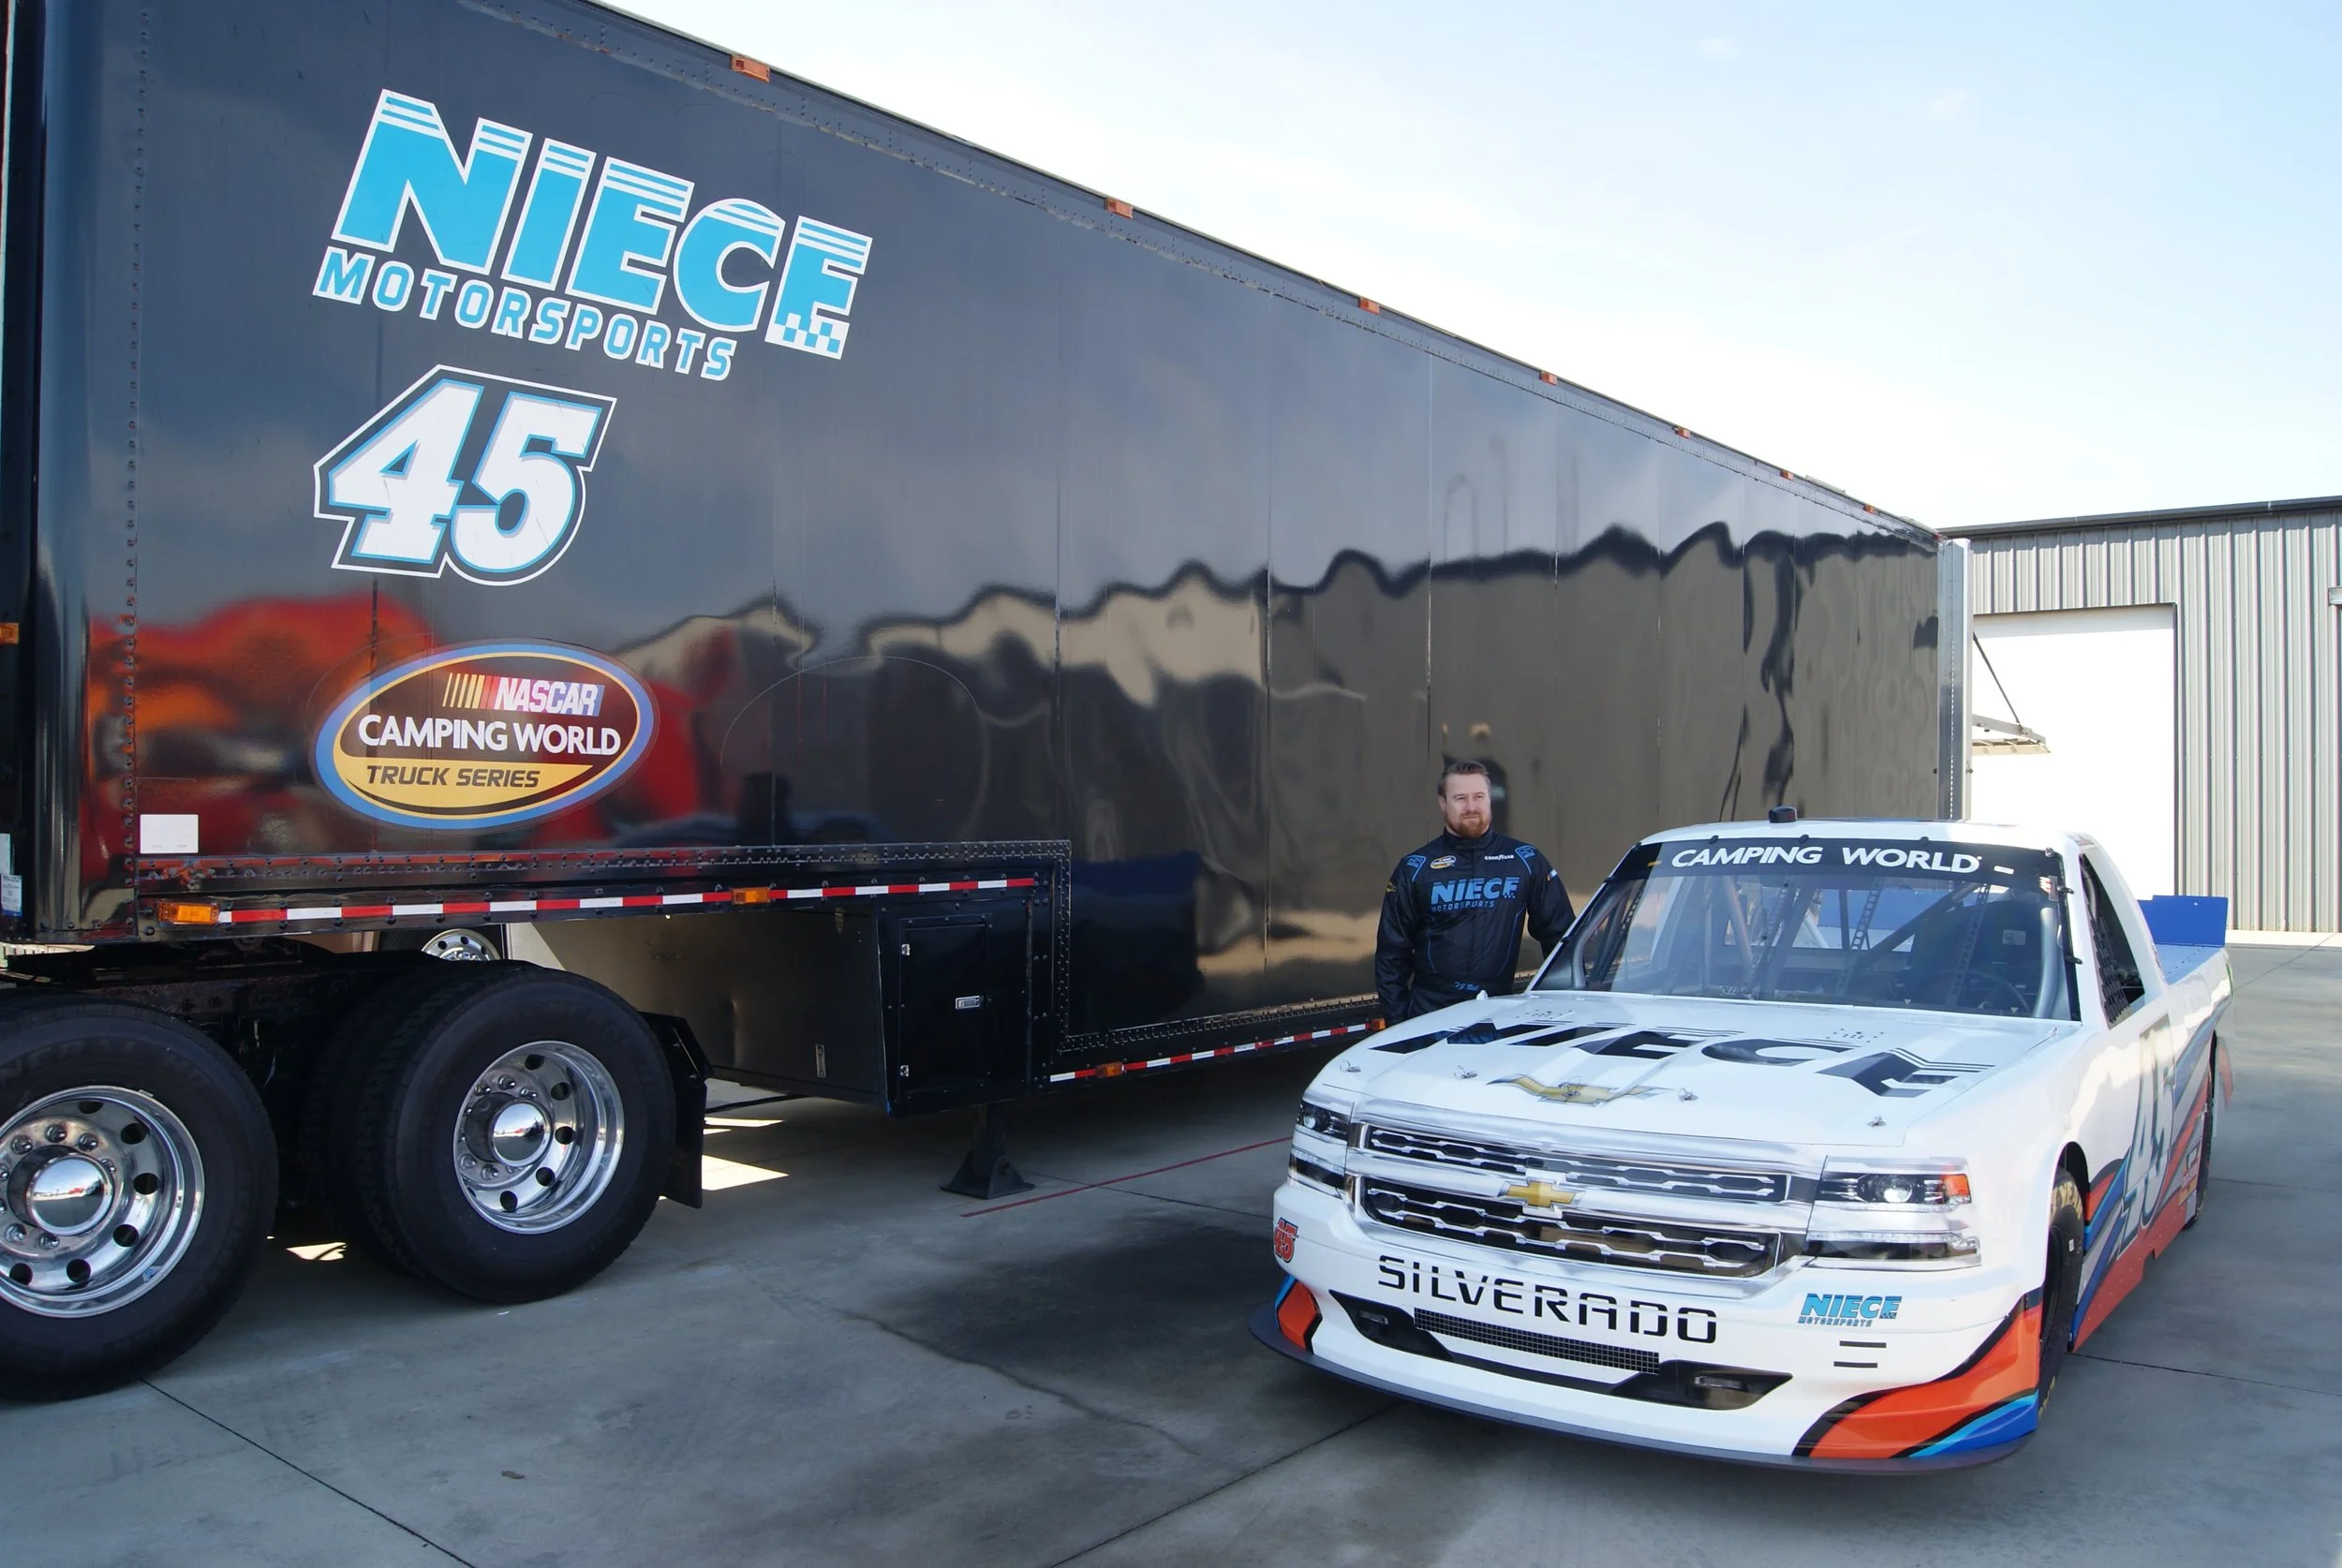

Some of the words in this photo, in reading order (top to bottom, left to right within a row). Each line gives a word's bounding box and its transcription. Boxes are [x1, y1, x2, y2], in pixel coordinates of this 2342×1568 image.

[331, 89, 872, 359] NIECE
[312, 246, 736, 380] MOTORSPORTS
[327, 377, 603, 574] 45
[494, 675, 598, 717] NASCAR
[358, 714, 508, 752] CAMPING
[513, 723, 621, 756] WORLD
[366, 765, 448, 787] TRUCK
[455, 768, 541, 789] SERIES
[1671, 846, 1824, 868] CAMPING
[1842, 847, 1980, 874] WORLD
[1430, 876, 1520, 906] NIECE
[1430, 900, 1496, 913] MOTORSPORTS
[1274, 1217, 1299, 1264] 45
[1378, 1255, 1717, 1344] SILVERADO
[1800, 1293, 1903, 1320] NIECE
[1797, 1315, 1875, 1328] MOTORSPORTS
